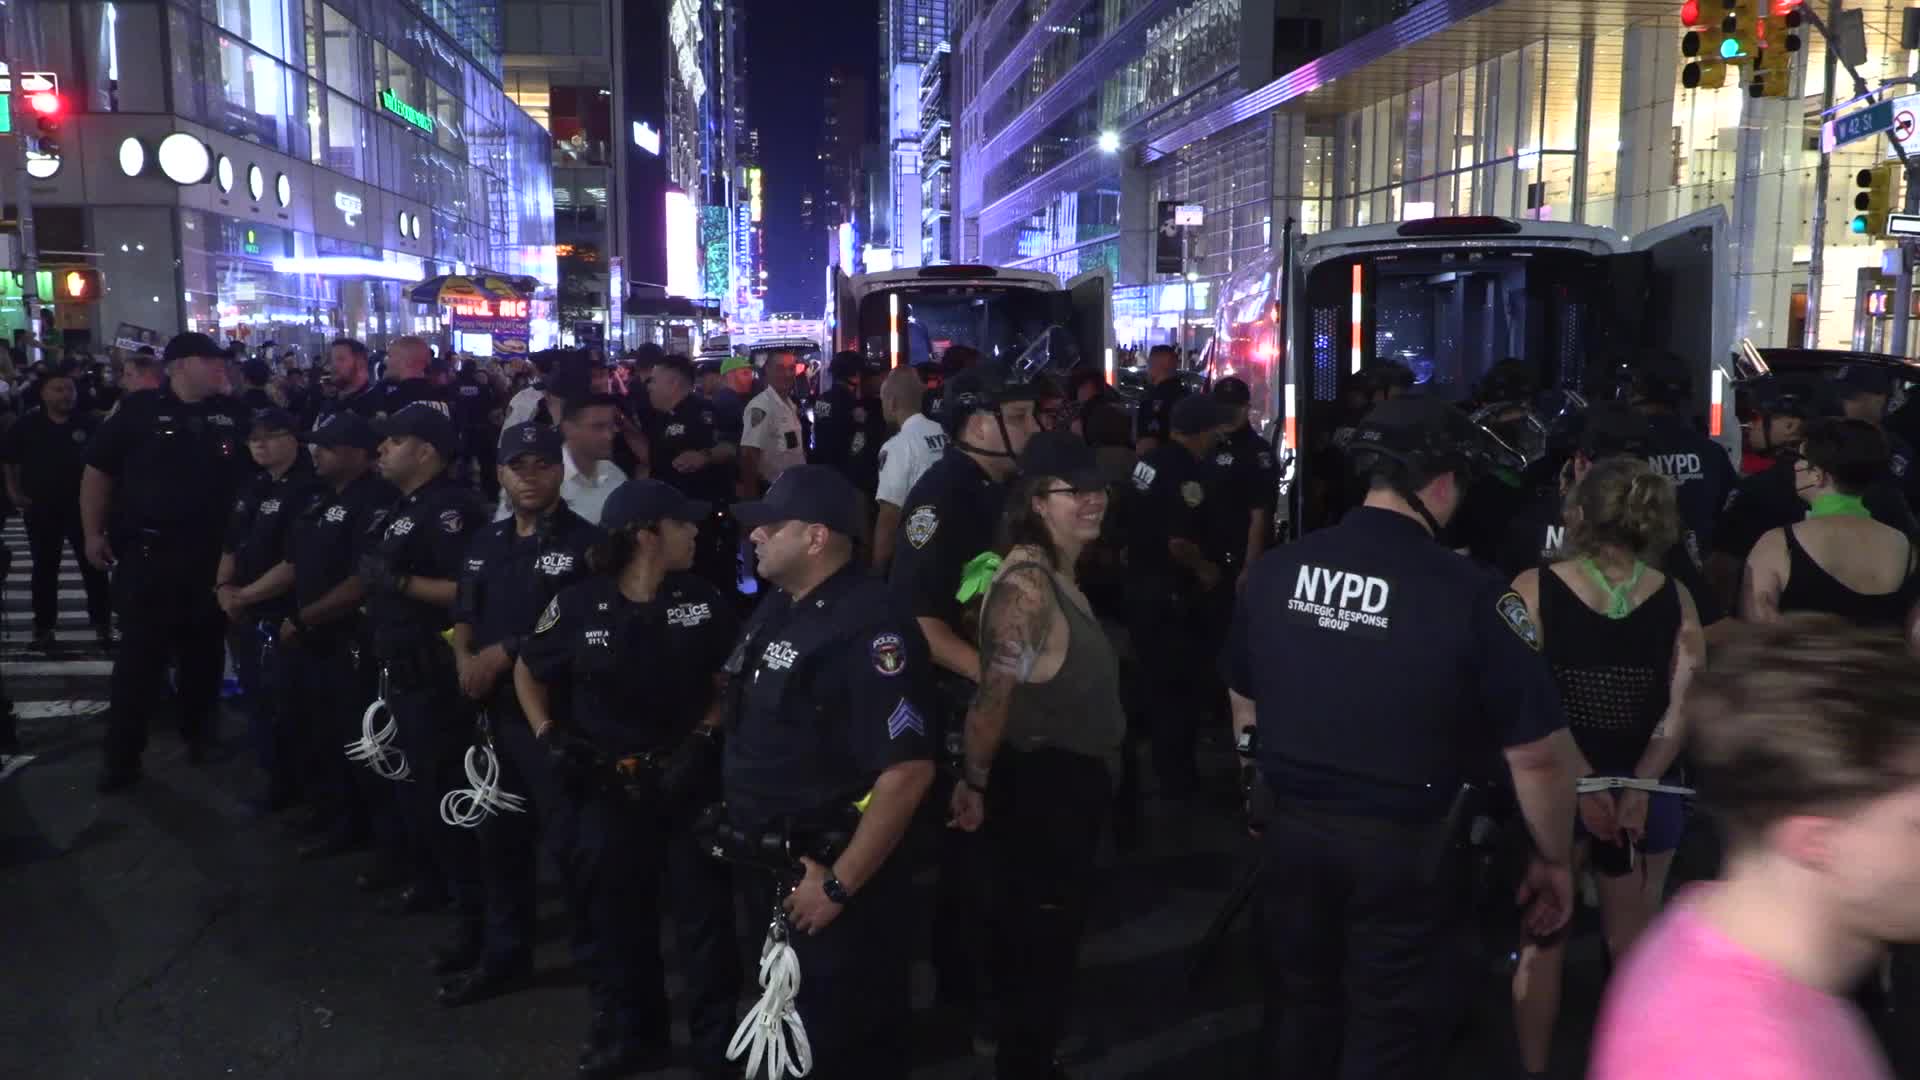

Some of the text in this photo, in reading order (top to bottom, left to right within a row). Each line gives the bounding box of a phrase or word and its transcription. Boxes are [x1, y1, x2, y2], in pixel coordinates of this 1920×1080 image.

[1848, 117, 1860, 134] 42
[1862, 113, 1873, 131] St
[1648, 453, 1701, 474] NYPD
[1293, 564, 1390, 614] NYPD
[666, 603, 711, 619] POLICE
[1287, 599, 1389, 628] STRATEGIC RESPONSE
[1318, 616, 1350, 632] GROUP
[765, 641, 800, 663] POLICE
